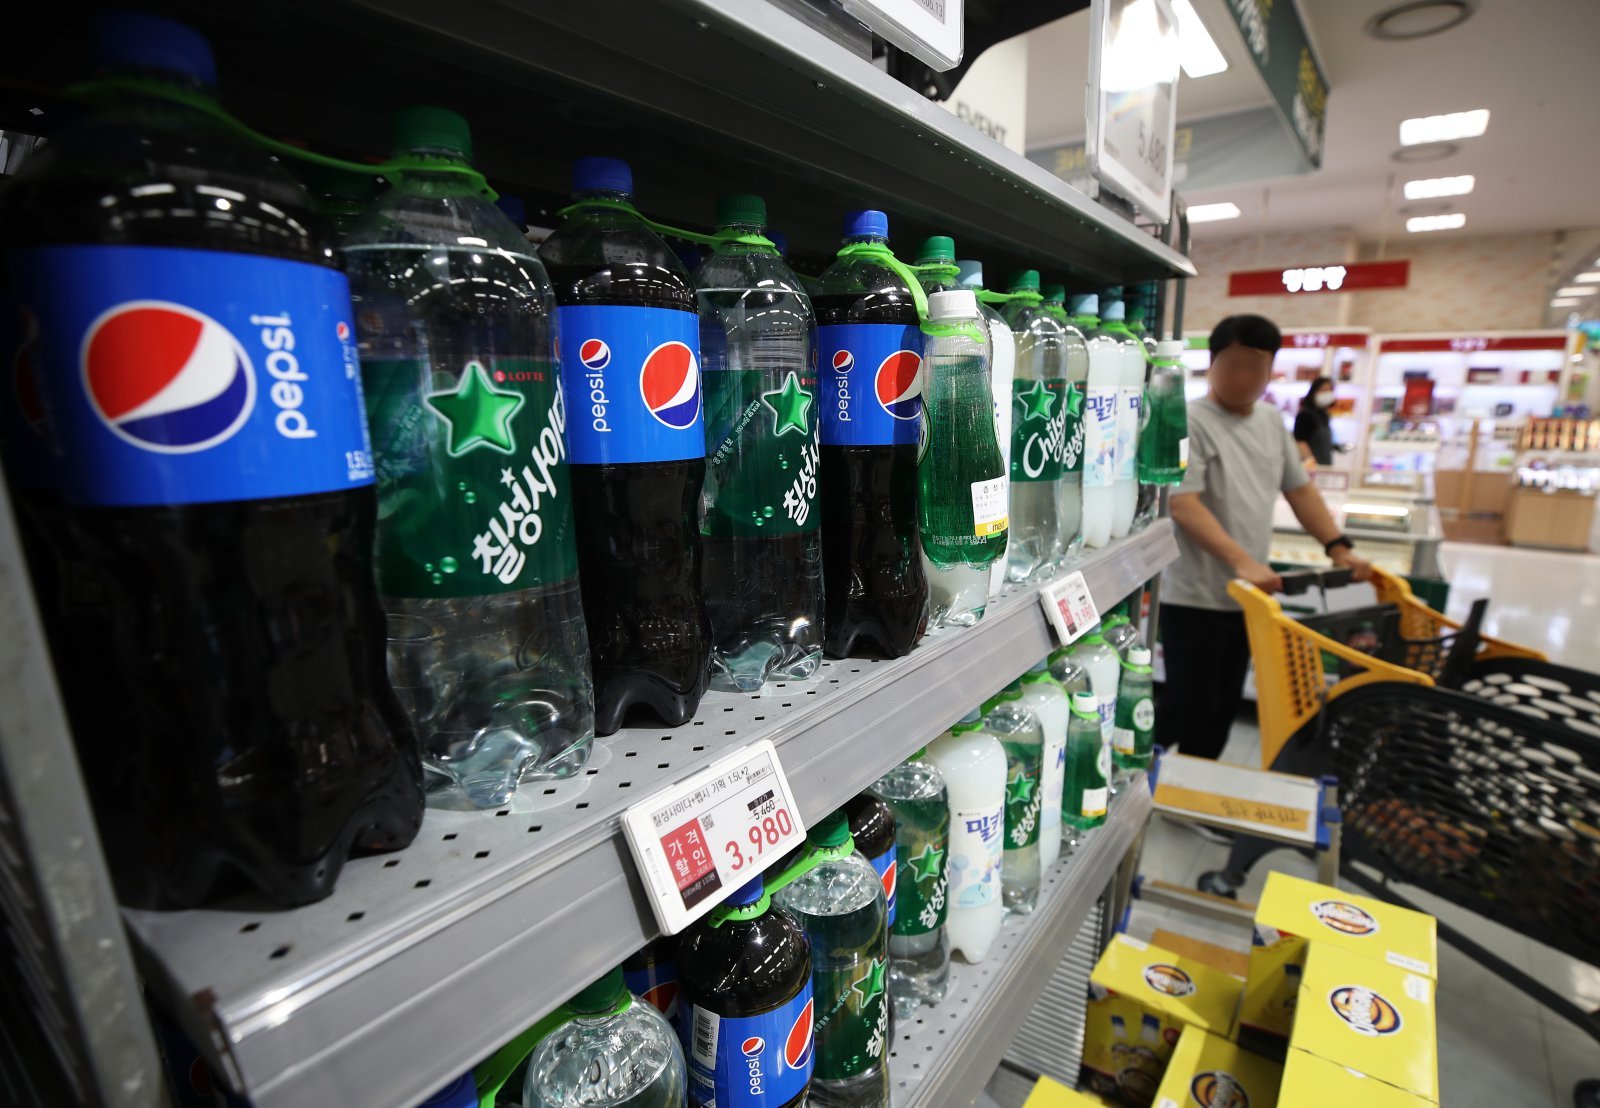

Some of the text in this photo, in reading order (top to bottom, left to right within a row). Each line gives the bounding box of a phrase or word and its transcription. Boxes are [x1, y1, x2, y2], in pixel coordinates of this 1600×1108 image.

[250, 314, 318, 439] pepsi
[508, 371, 544, 381] LOTTE
[585, 371, 612, 432] pepsi
[835, 376, 851, 421] pepsi
[725, 808, 792, 871] 3,980
[746, 1056, 765, 1096] pepsi
